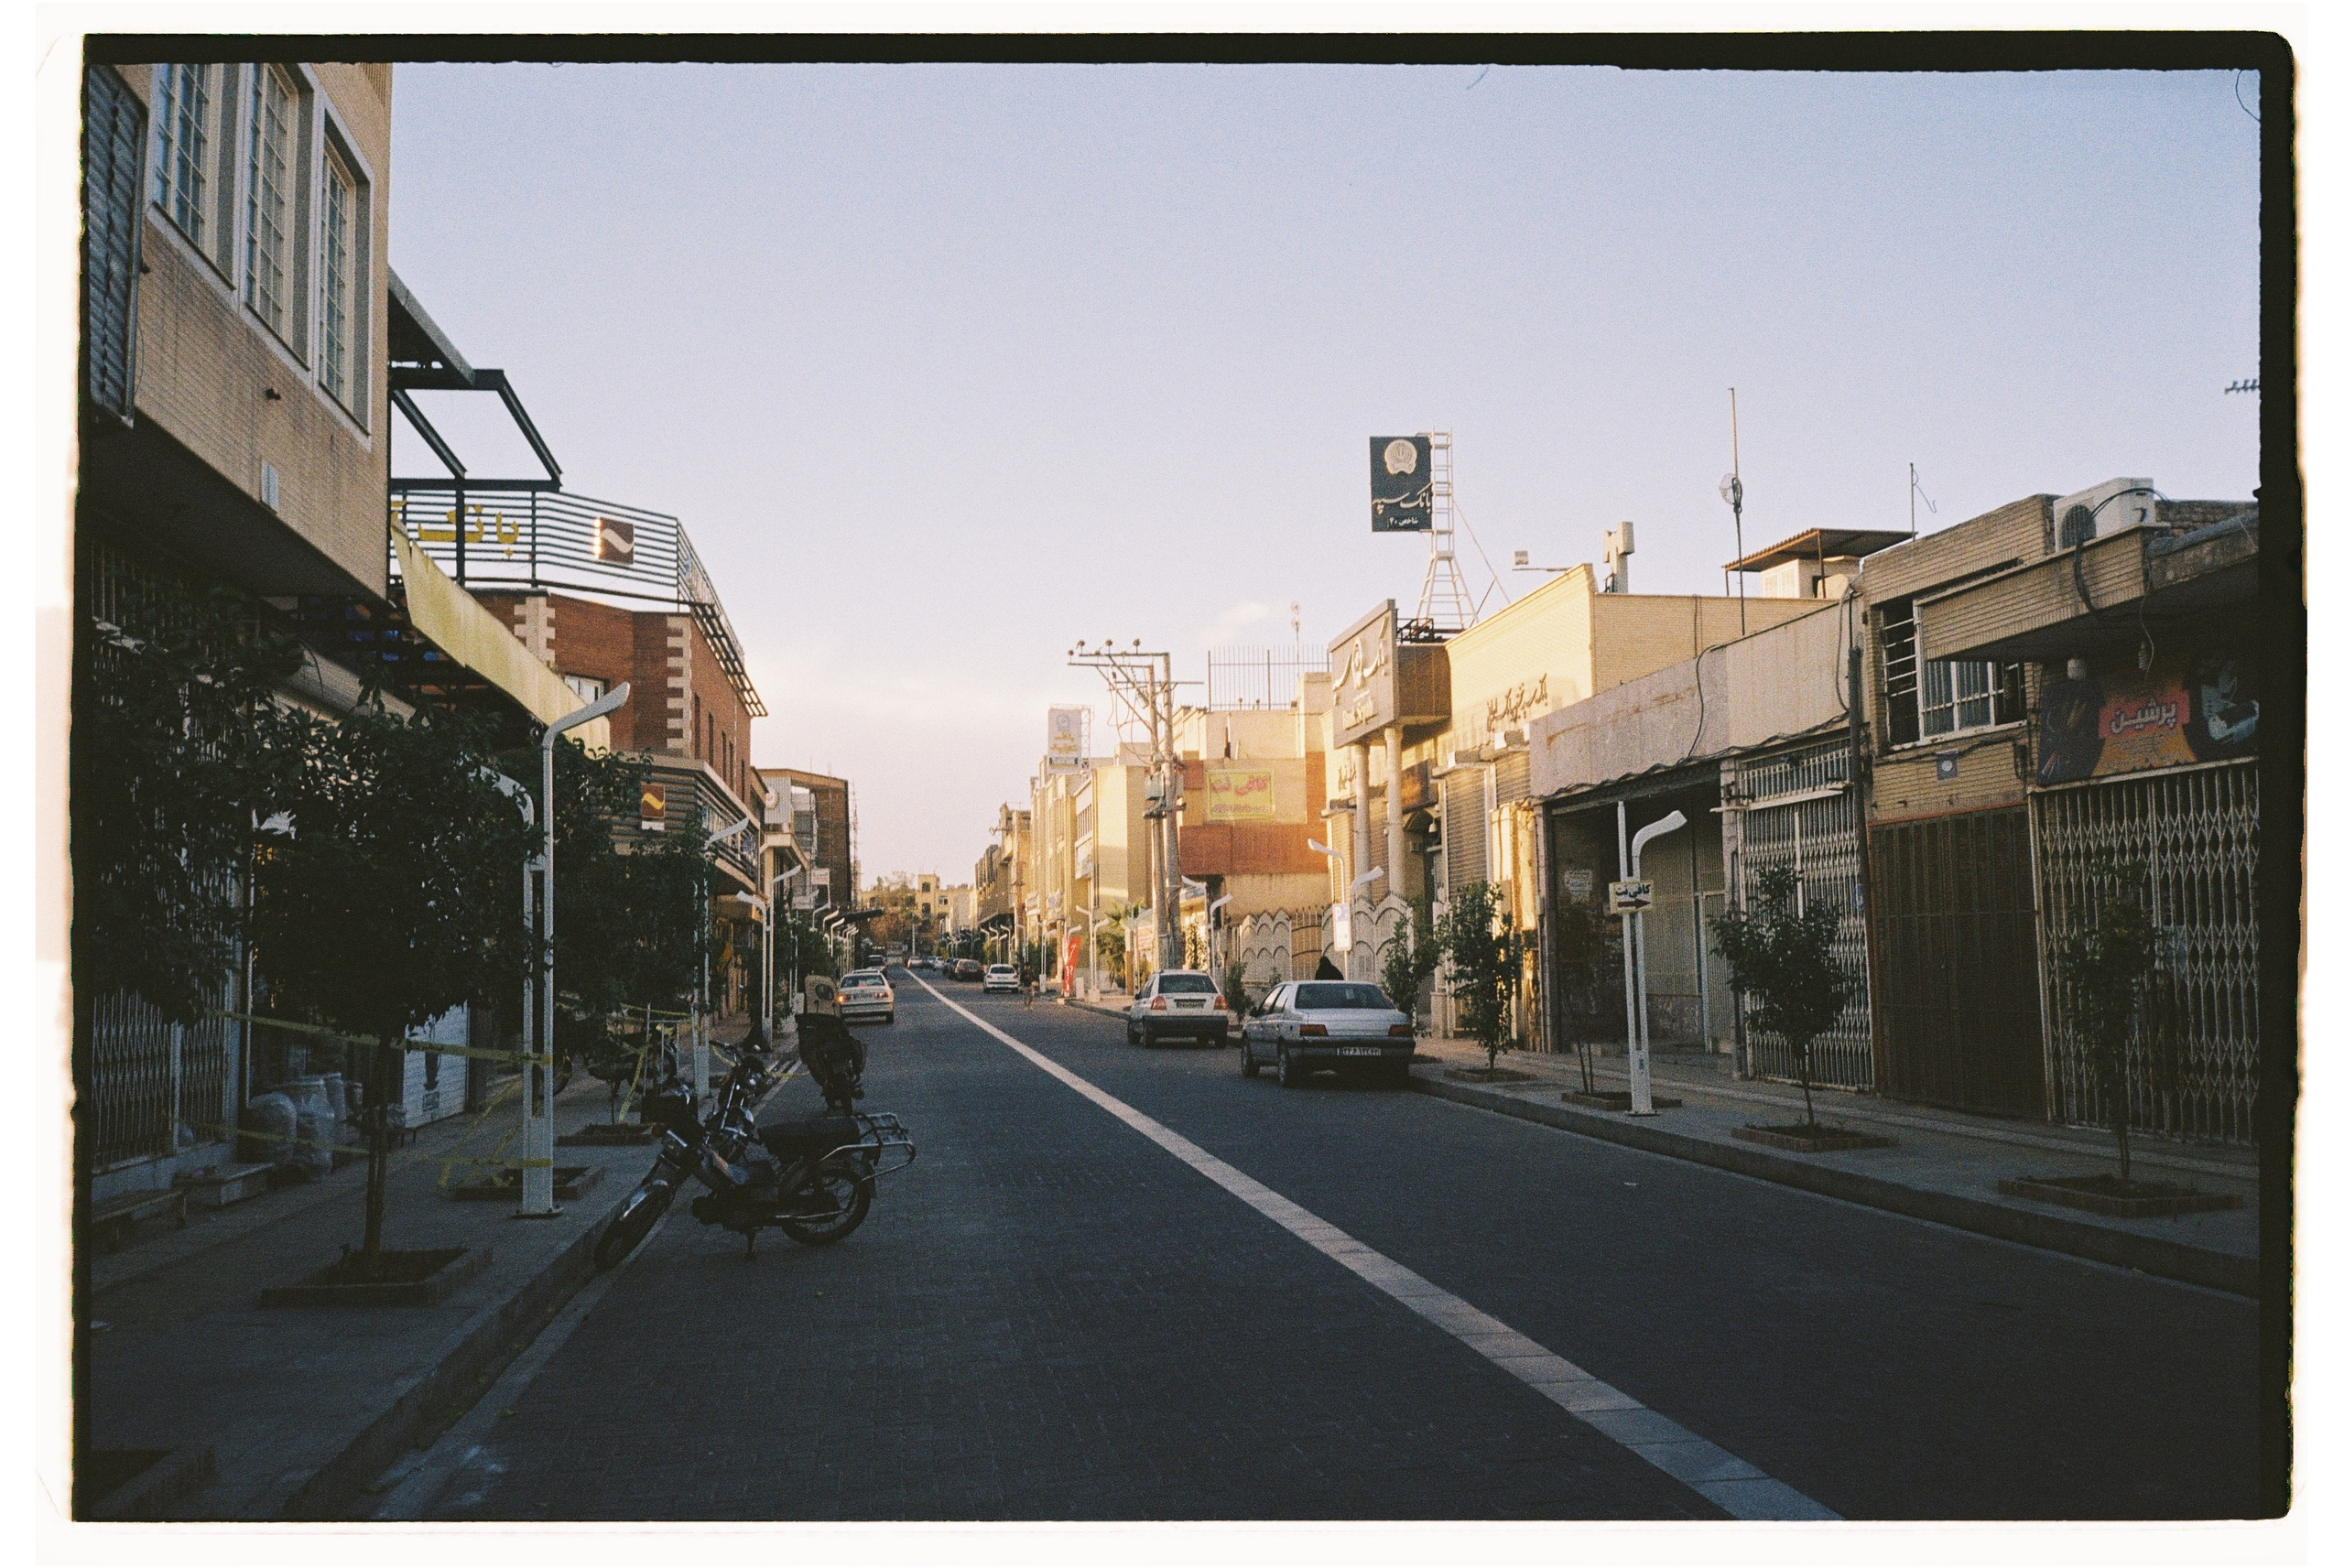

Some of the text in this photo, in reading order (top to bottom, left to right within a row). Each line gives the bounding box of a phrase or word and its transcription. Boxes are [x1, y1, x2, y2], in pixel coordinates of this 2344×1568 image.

[1372, 481, 1433, 515] بانک سپه
[1363, 615, 1389, 677] بانک
[1535, 672, 1548, 706] بانک
[2110, 697, 2177, 734] پرشین
[1233, 774, 1268, 797] کافی
[1615, 883, 1651, 898] کافی نت
